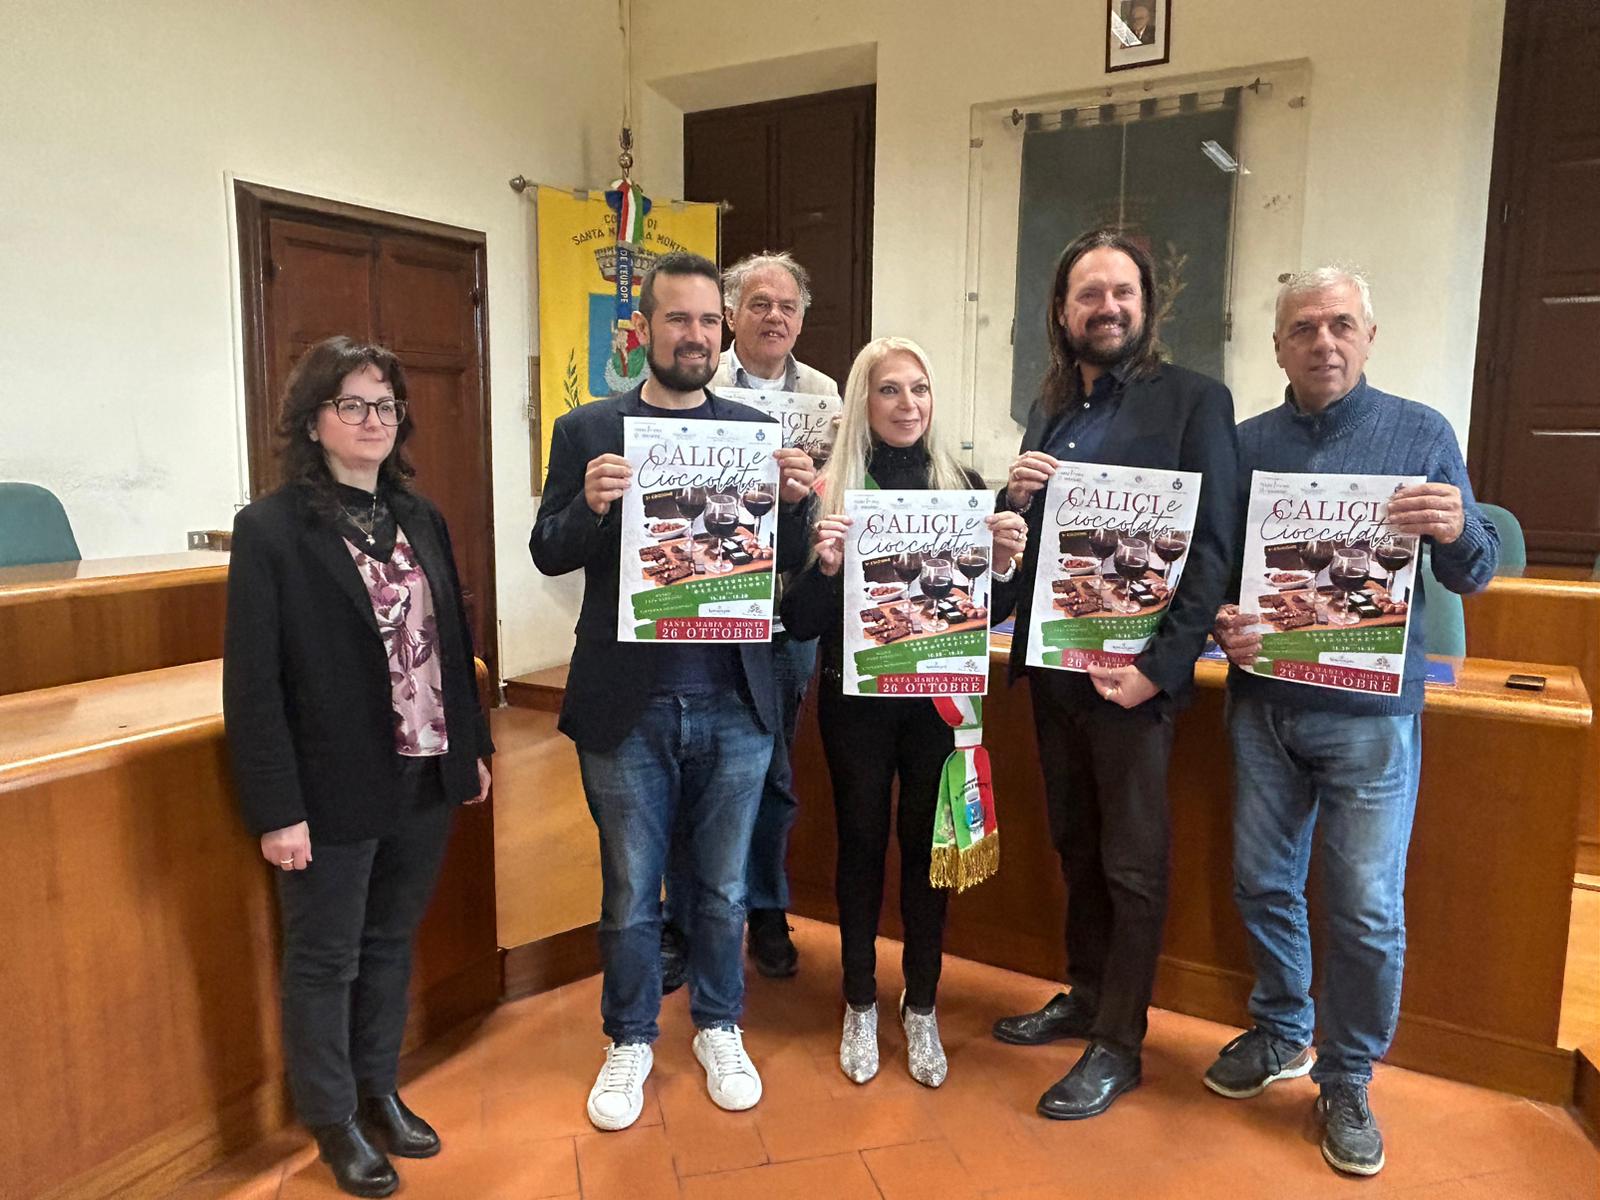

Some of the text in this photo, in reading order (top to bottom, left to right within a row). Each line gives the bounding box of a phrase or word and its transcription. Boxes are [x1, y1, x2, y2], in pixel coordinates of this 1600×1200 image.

[647, 219, 657, 230] DI
[571, 229, 605, 246] SANTA
[649, 444, 767, 468] CALICI e
[638, 455, 761, 494] Cioccolato
[1068, 487, 1182, 515] CALICI e
[1273, 499, 1381, 522] CALICI
[867, 514, 980, 534] CALICI e
[1056, 497, 1174, 538] Cioccolato
[1260, 509, 1399, 548] Cioccolato
[858, 524, 974, 558] Cioccolato
[662, 627, 764, 639] 26 OTTOBRE
[1067, 658, 1082, 668] 26
[882, 682, 980, 692] 26 OTTOBRE
[1279, 668, 1392, 692] 26 OTTOBRE
